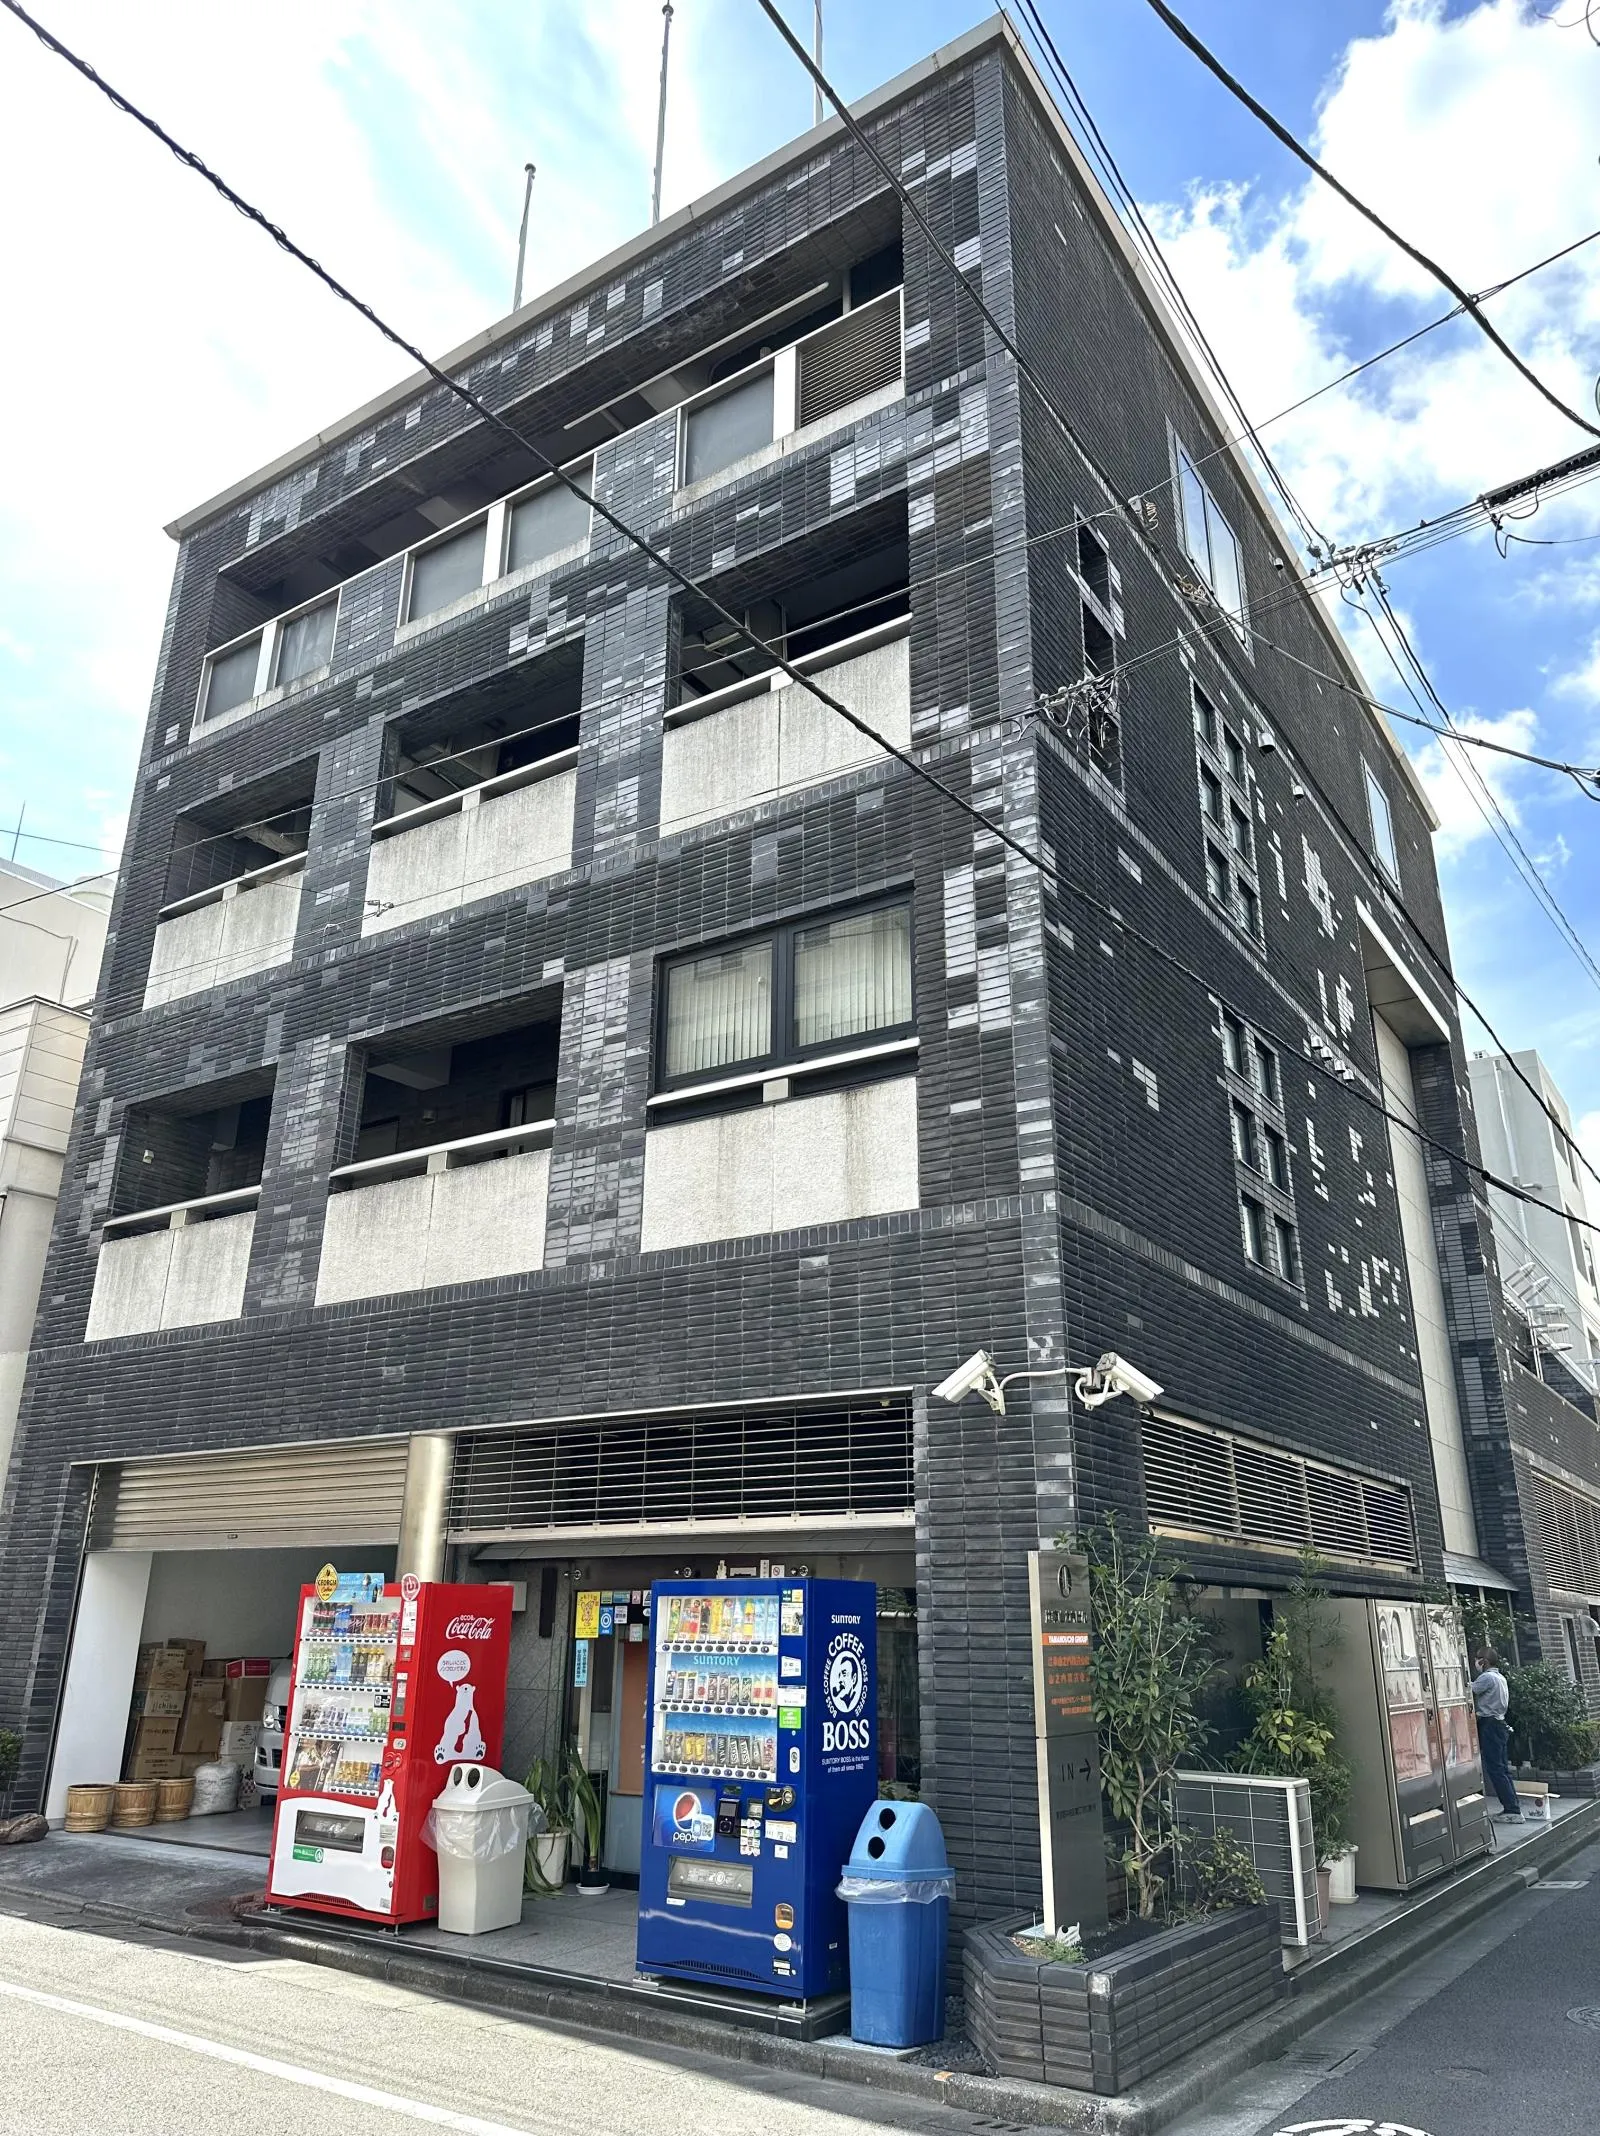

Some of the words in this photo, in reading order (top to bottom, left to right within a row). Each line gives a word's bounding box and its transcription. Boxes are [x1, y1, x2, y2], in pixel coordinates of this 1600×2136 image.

[446, 1616, 496, 1640] Coca-Cola
[831, 1614, 861, 1624] SUNTORY
[828, 1632, 864, 1658] COFFEE
[694, 1655, 740, 1666] SUNTORY
[824, 1658, 832, 1695] COFFEE
[826, 1696, 837, 1718] BOSS
[856, 1684, 868, 1717] COFFEE
[822, 1719, 870, 1752] BOSS
[730, 1740, 739, 1764] BOSS
[740, 1740, 750, 1765] BOSS
[822, 1757, 840, 1765] SUNTORY
[1061, 1763, 1074, 1782] IN
